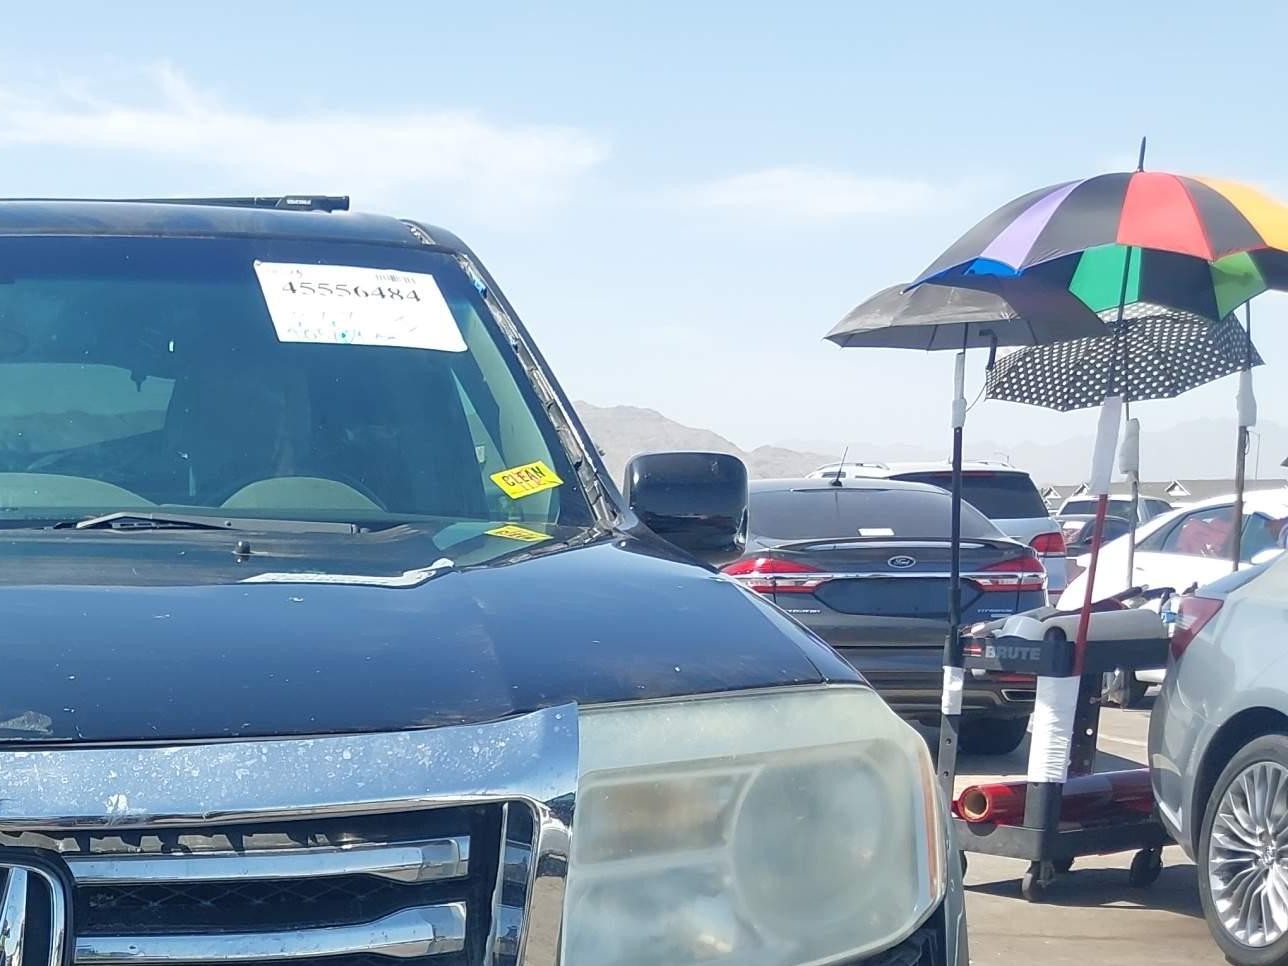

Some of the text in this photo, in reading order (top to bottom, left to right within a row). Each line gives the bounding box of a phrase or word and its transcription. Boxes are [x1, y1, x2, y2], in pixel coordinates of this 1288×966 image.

[281, 281, 422, 303] 45556484
[501, 465, 547, 488] CLEAN
[984, 645, 1042, 661] BRUTE
